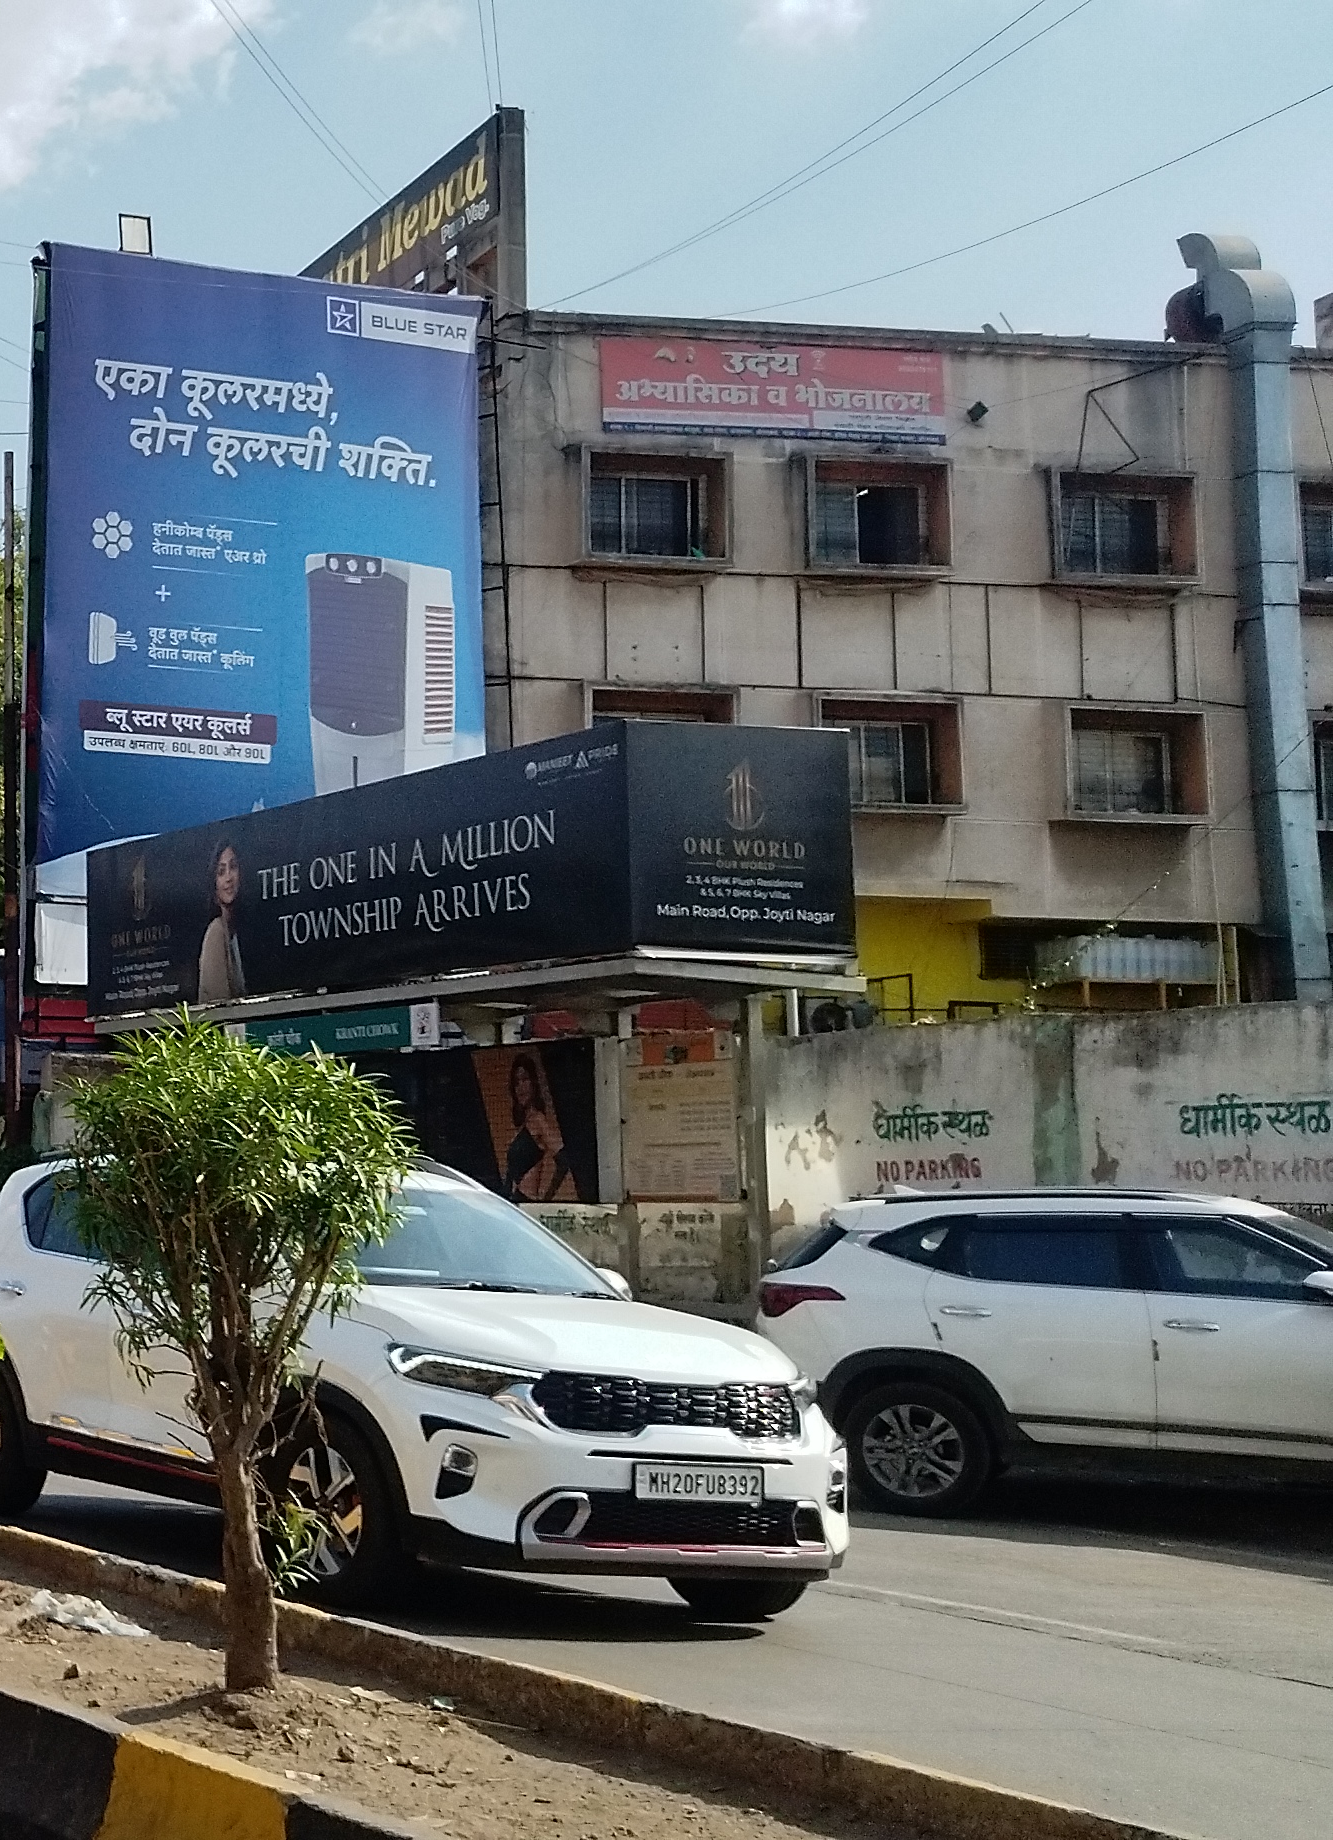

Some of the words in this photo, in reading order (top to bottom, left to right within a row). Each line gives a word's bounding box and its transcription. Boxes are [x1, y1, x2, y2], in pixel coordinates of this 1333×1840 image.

[378, 131, 488, 272] Mewad
[371, 315, 419, 334] BLUE
[423, 321, 468, 341] STAR
[721, 350, 801, 379] उदय
[94, 358, 172, 401] एका
[181, 372, 339, 426] कूलरमध्ये,
[615, 374, 760, 406] अभ्यासिका
[765, 385, 789, 407] व
[796, 378, 931, 414] भोजनालय
[129, 410, 198, 457] दोन
[206, 426, 330, 479] कूलरची
[339, 436, 438, 489] शक्ति.
[152, 540, 183, 556] देतात
[148, 644, 179, 661] देतात
[105, 708, 133, 733] ब्लू
[131, 709, 168, 729] स्टार
[171, 713, 205, 733] एयर
[207, 713, 252, 739] कूलर्स
[258, 862, 300, 900] THE
[309, 850, 357, 891] ONE
[368, 841, 398, 880] IN
[409, 838, 435, 878] A
[440, 809, 557, 871] MILLION
[683, 836, 726, 856] ONE
[732, 839, 806, 860] WORLD
[278, 896, 403, 947] TOWNSHIP
[413, 873, 532, 933] ARRIVES
[656, 903, 690, 917] Main
[692, 904, 730, 919] Road,
[729, 906, 761, 922] Opp.
[763, 907, 794, 923] Joyti
[796, 909, 836, 925] Nagar
[876, 1160, 901, 1181] NO
[1173, 1159, 1208, 1182] NO
[647, 1470, 761, 1498] MH20FU8392
